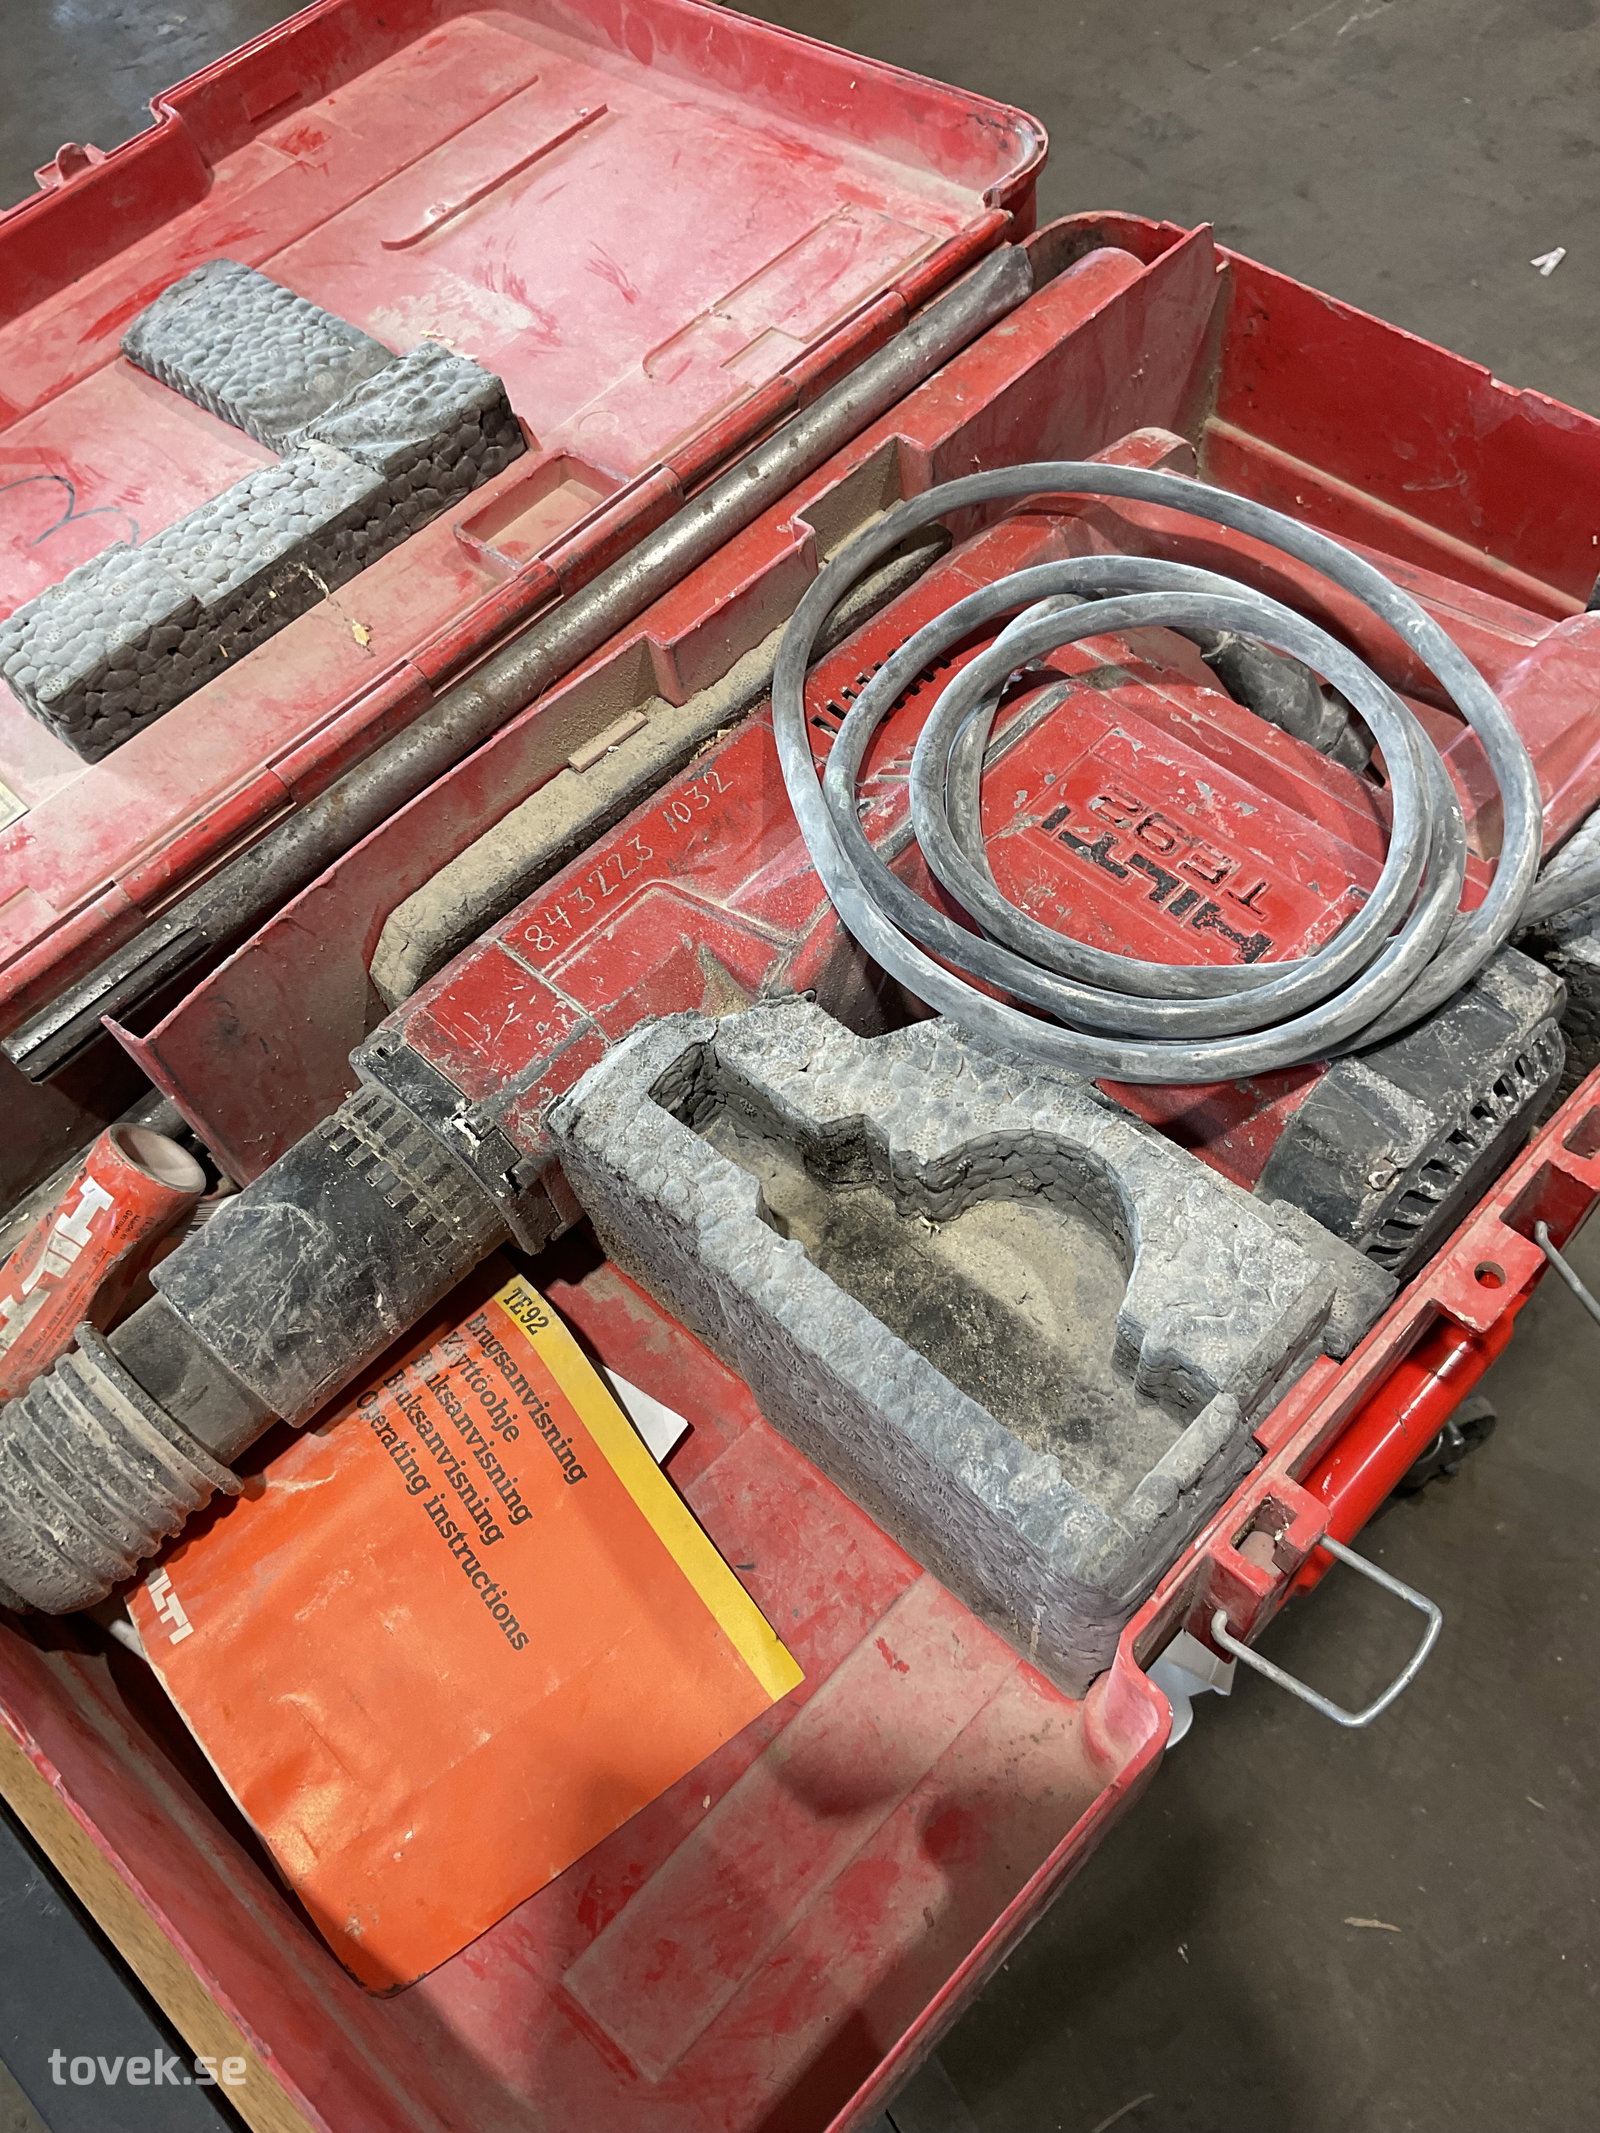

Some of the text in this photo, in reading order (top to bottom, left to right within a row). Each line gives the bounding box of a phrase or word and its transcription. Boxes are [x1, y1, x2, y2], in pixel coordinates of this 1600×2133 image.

[525, 770, 734, 951] 843223 1032
[1039, 803, 1274, 964] HILTI
[0, 1176, 114, 1362] HILT
[410, 1350, 533, 1526] Buksanvisning
[464, 1312, 588, 1485] Brugsanvisning
[356, 1390, 530, 1651] Operating instructions
